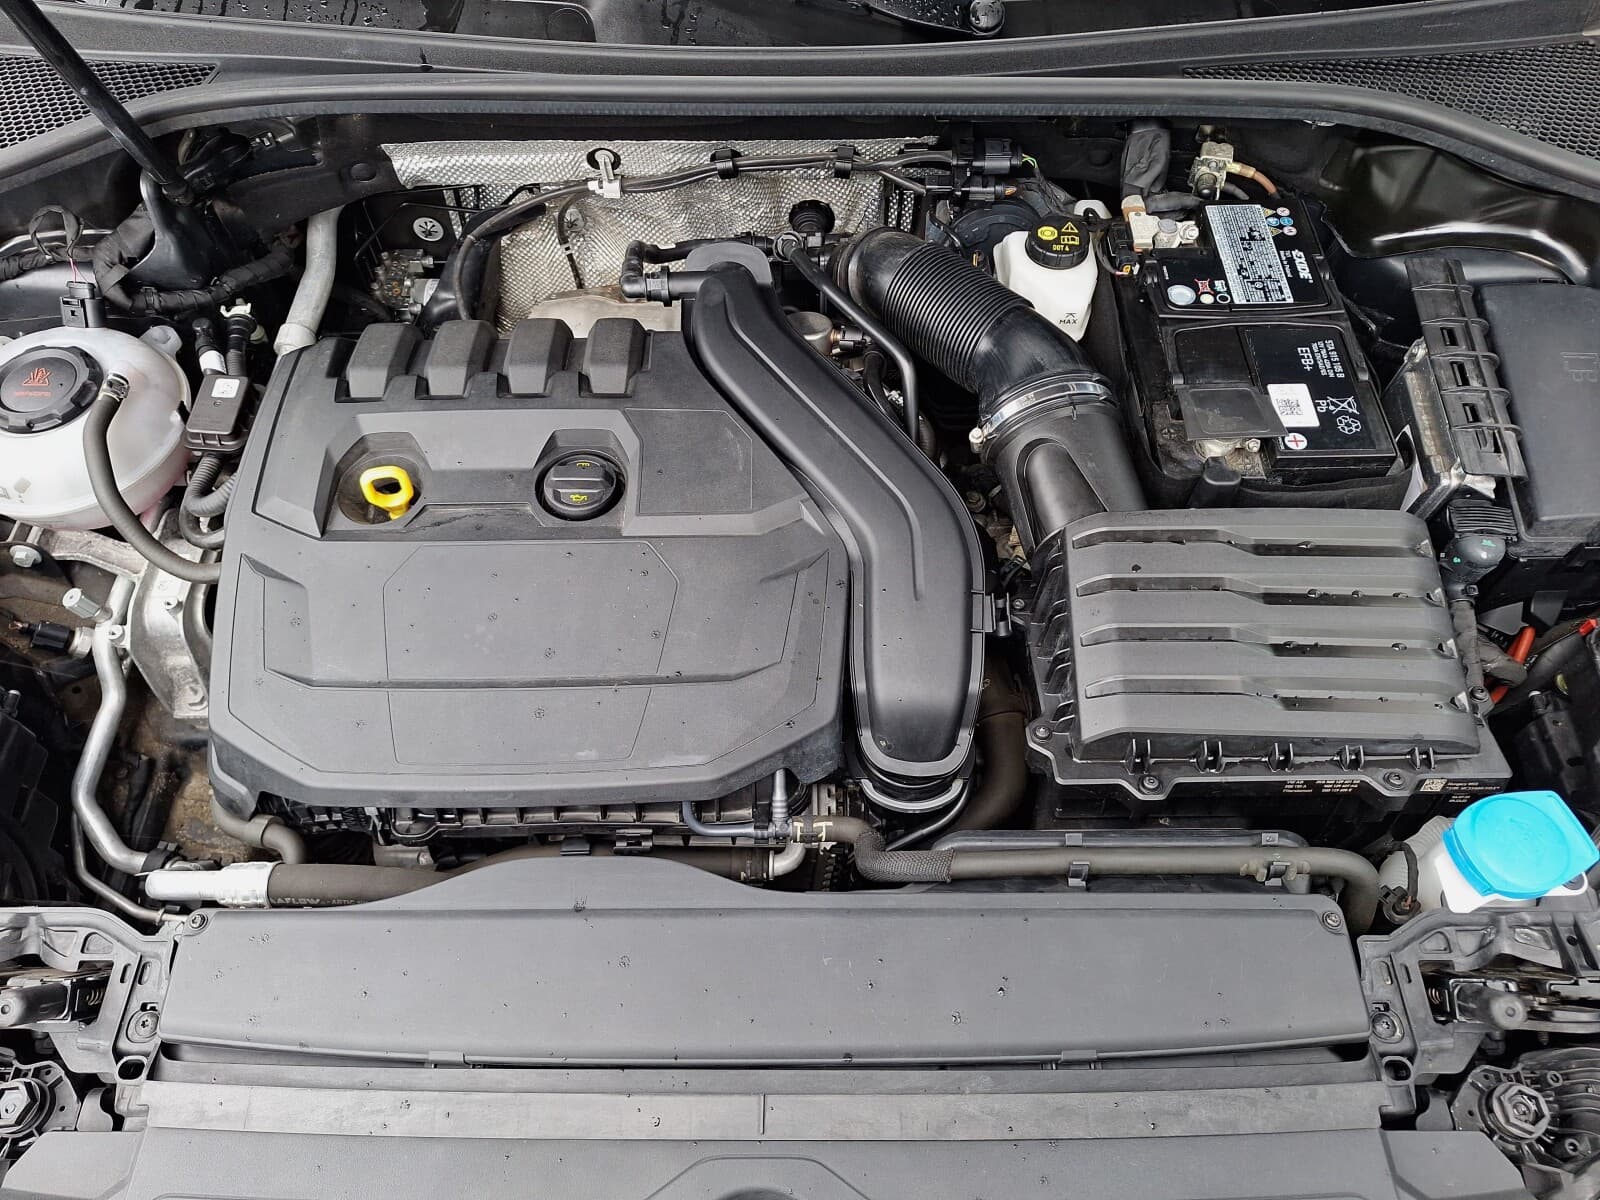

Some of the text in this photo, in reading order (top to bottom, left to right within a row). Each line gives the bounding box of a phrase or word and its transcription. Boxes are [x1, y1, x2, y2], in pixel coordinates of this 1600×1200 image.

[1292, 249, 1313, 280] EXIDE
[1297, 347, 1314, 372] EFB+
[1315, 400, 1328, 412] Pb
